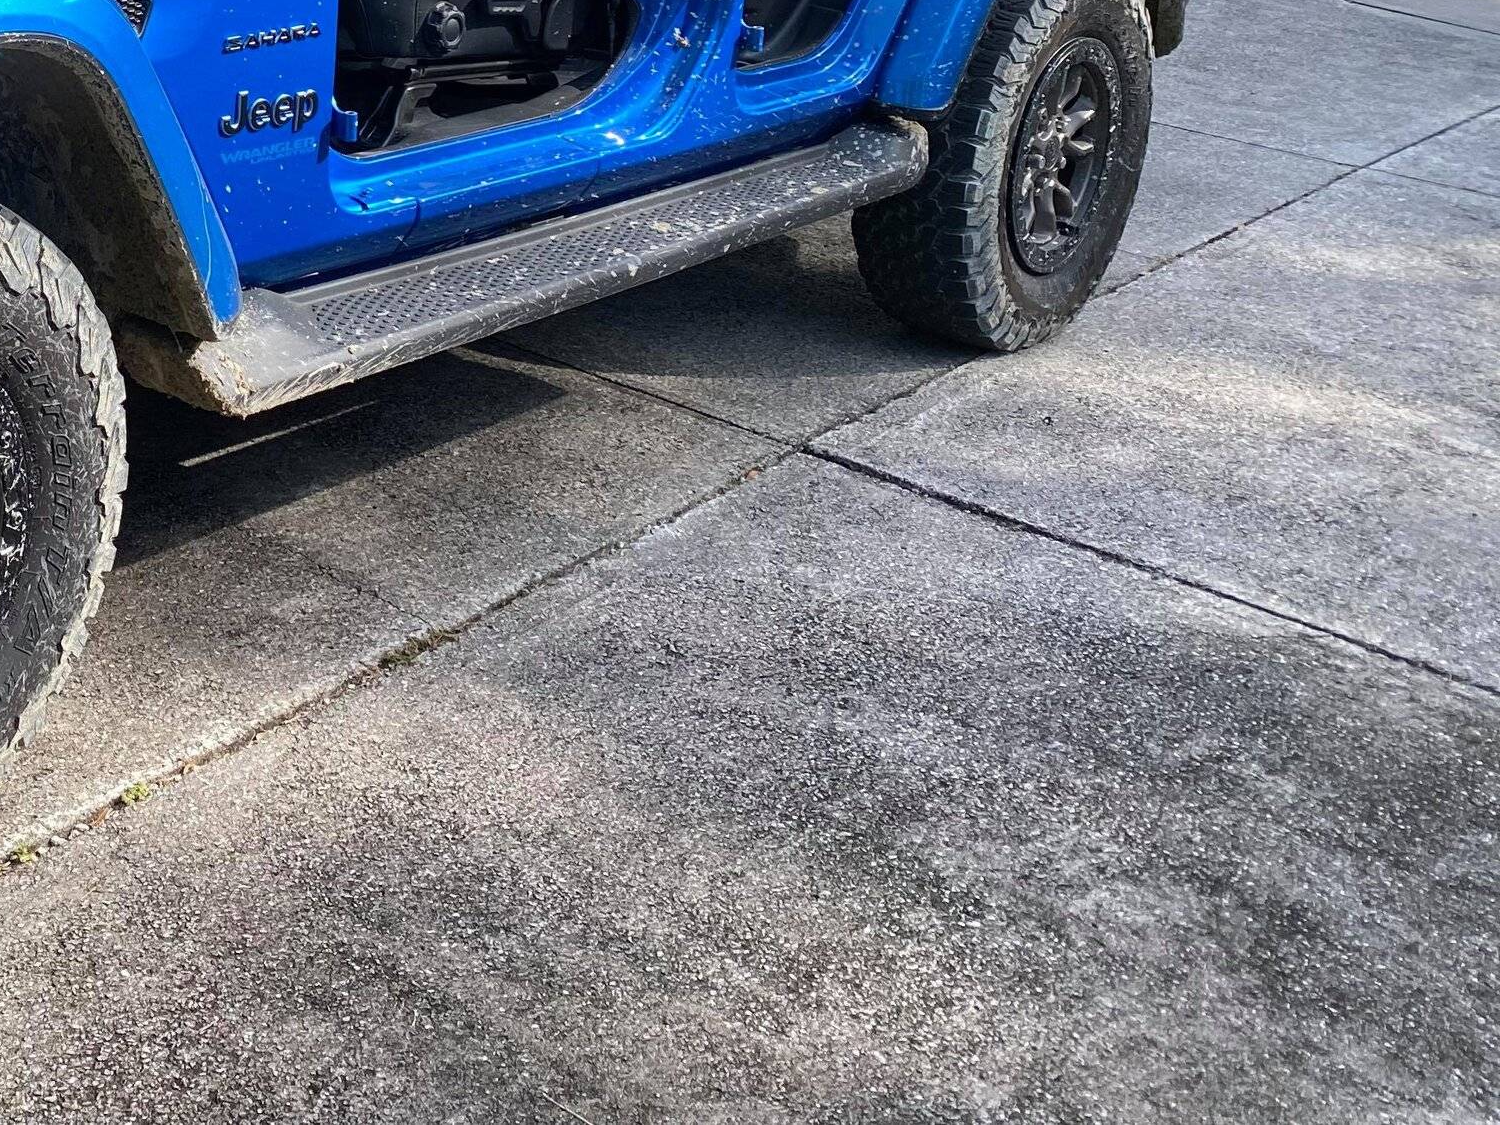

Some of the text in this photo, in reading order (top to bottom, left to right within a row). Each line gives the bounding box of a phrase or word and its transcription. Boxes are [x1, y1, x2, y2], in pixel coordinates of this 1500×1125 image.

[222, 22, 320, 54] SAHARA
[219, 89, 318, 137] Jeep
[220, 137, 316, 164] WRANGLER
